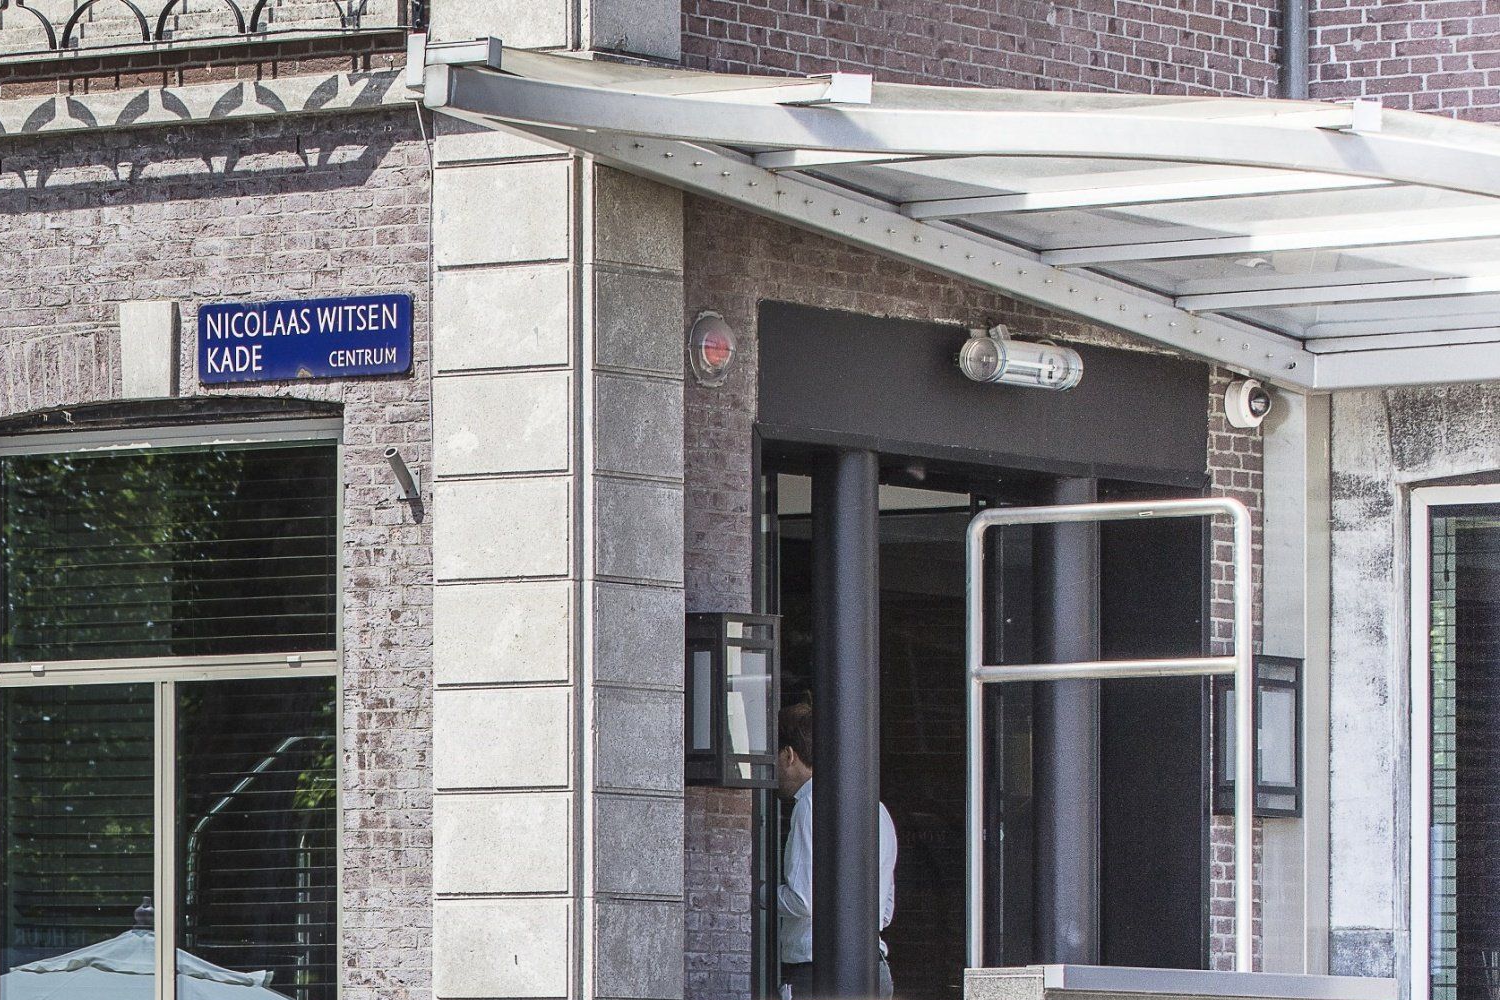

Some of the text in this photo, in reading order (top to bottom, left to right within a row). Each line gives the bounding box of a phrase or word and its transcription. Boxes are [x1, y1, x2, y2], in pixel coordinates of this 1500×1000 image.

[206, 303, 397, 340] NICOLAAS WITSEN
[207, 345, 397, 373] KADE CENTRUM
